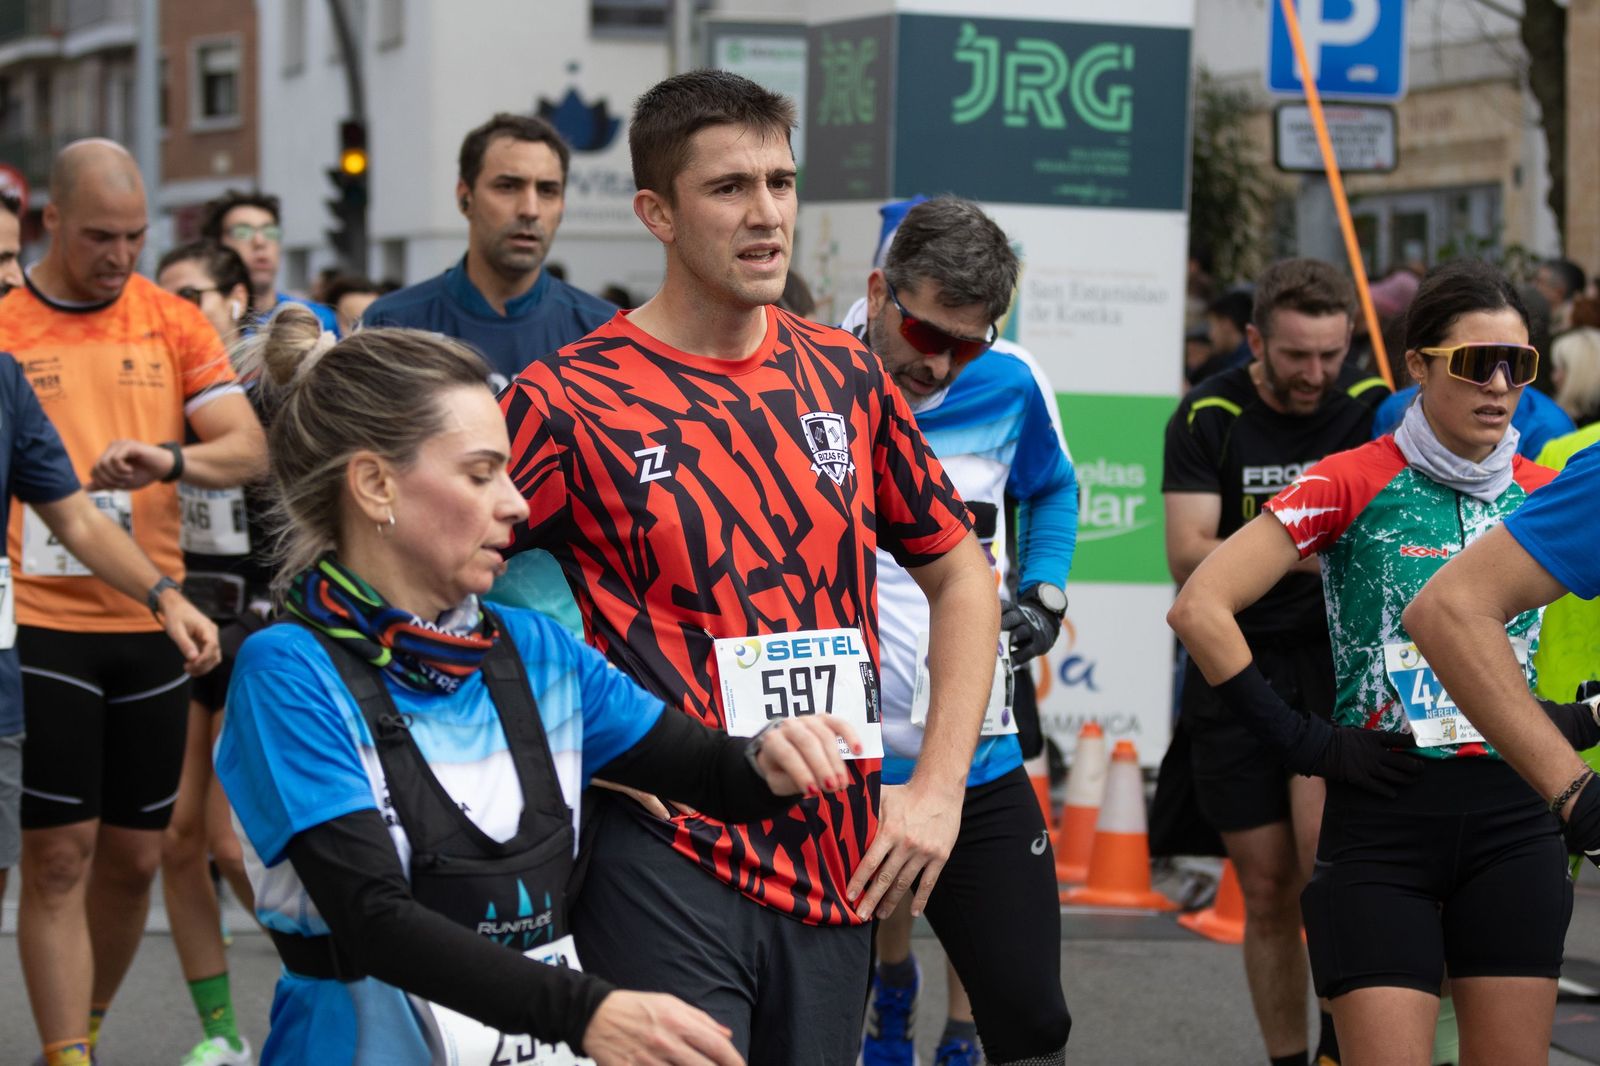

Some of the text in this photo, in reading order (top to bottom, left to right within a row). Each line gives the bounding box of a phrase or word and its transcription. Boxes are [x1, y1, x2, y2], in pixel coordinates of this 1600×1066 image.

[953, 22, 1134, 132] JRG
[818, 451, 846, 462] BIZAS FC
[1077, 457, 1145, 488] elas
[1081, 484, 1146, 528] lar
[766, 635, 860, 662] SETEL
[761, 664, 836, 721] 597
[478, 910, 553, 935] RUNITUDE
